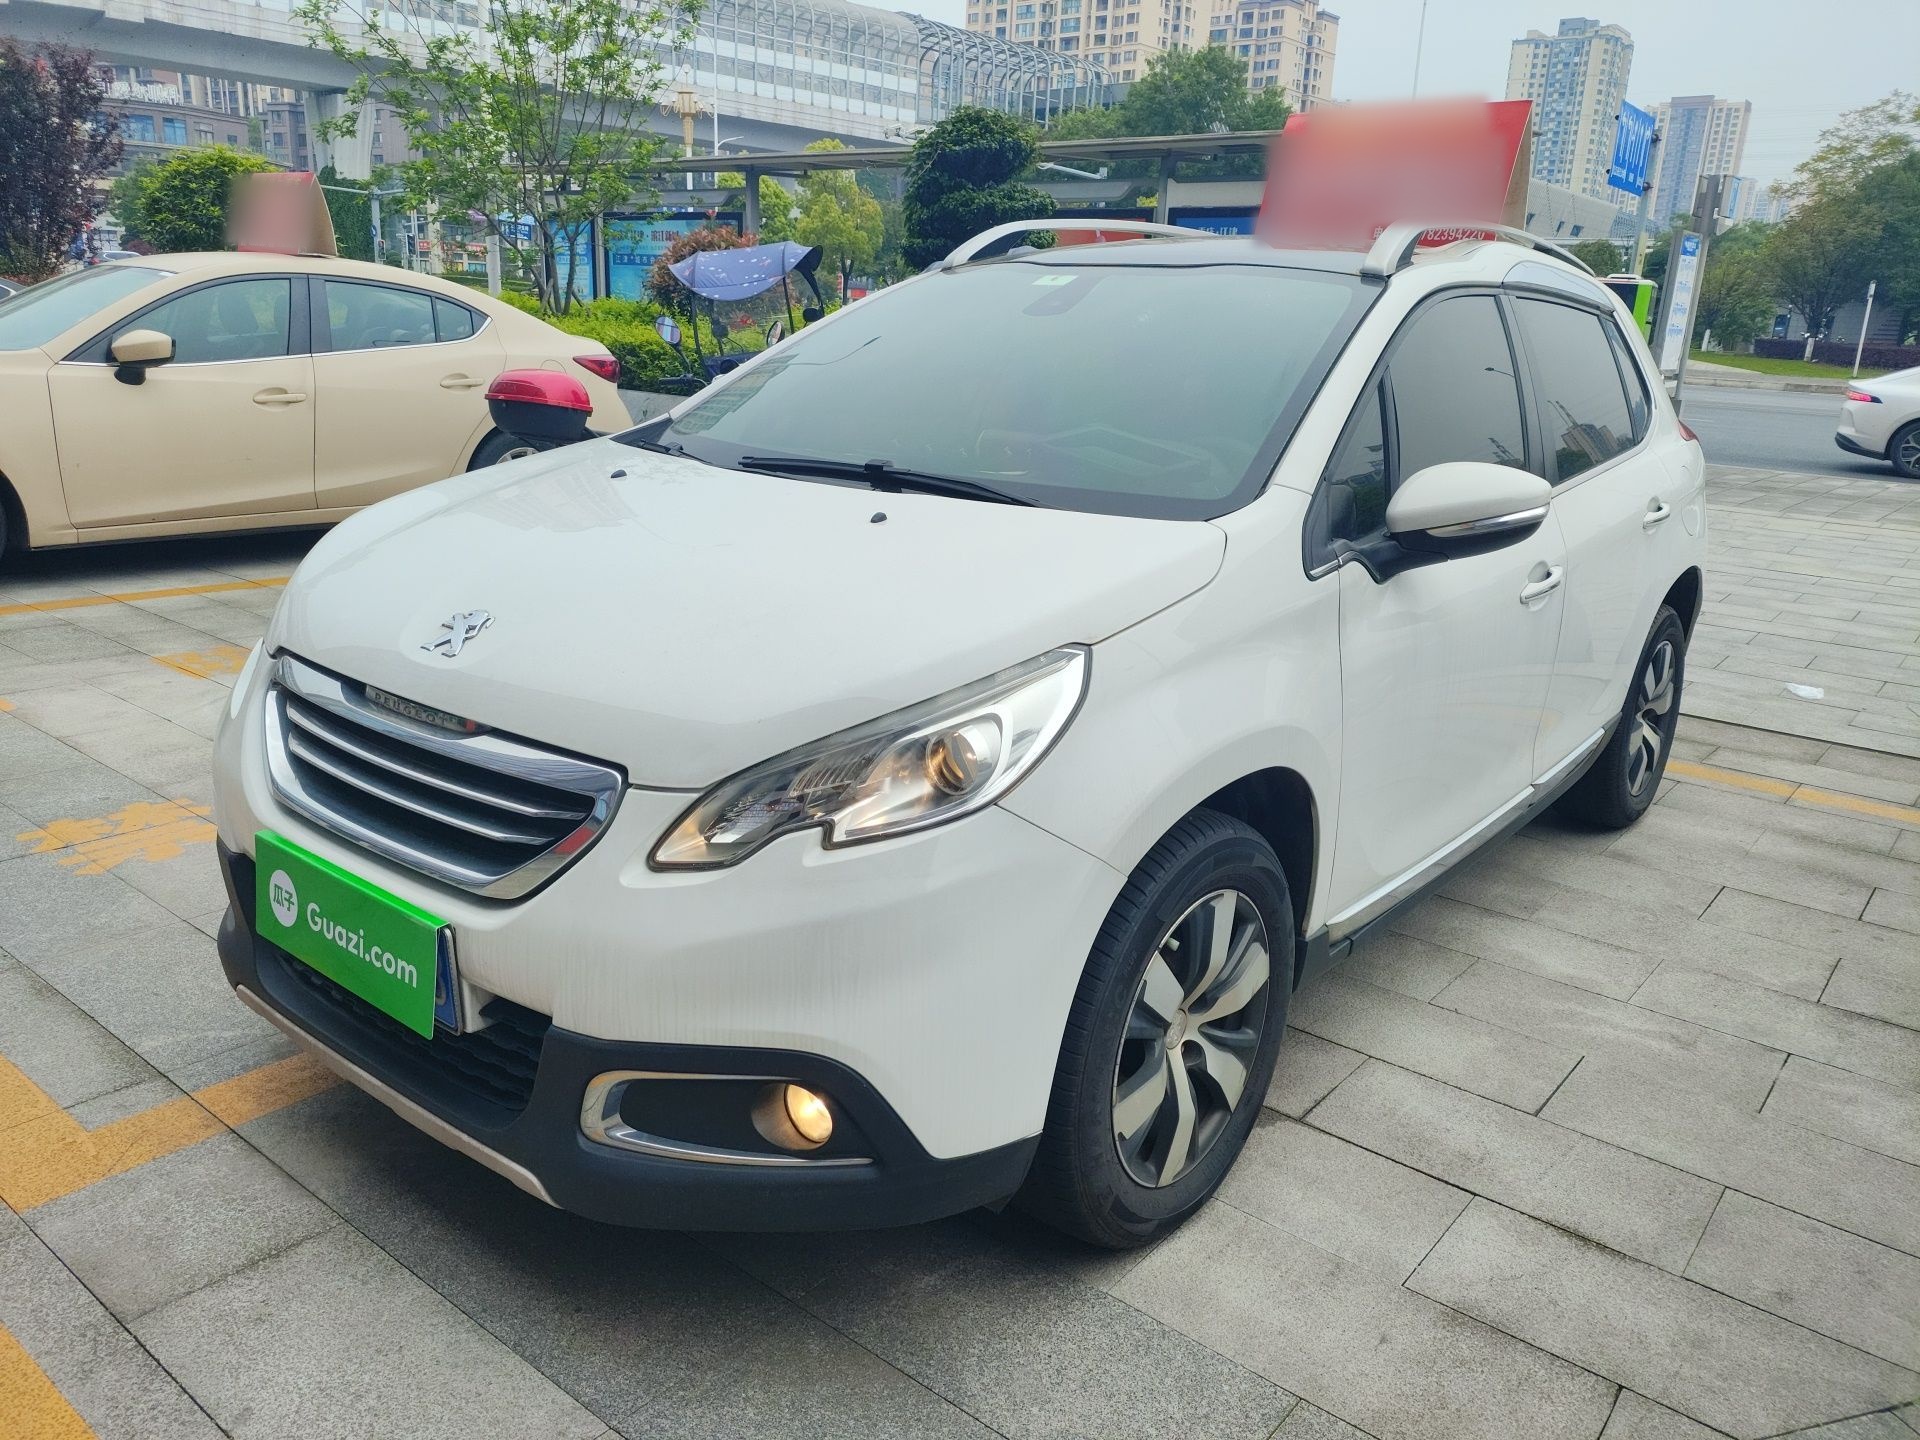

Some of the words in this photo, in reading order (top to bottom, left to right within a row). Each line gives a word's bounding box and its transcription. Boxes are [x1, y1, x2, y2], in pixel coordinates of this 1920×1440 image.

[375, 692, 448, 726] PEUGEOT
[273, 883, 295, 912] 瓜子
[306, 902, 418, 989] Guazi.com
